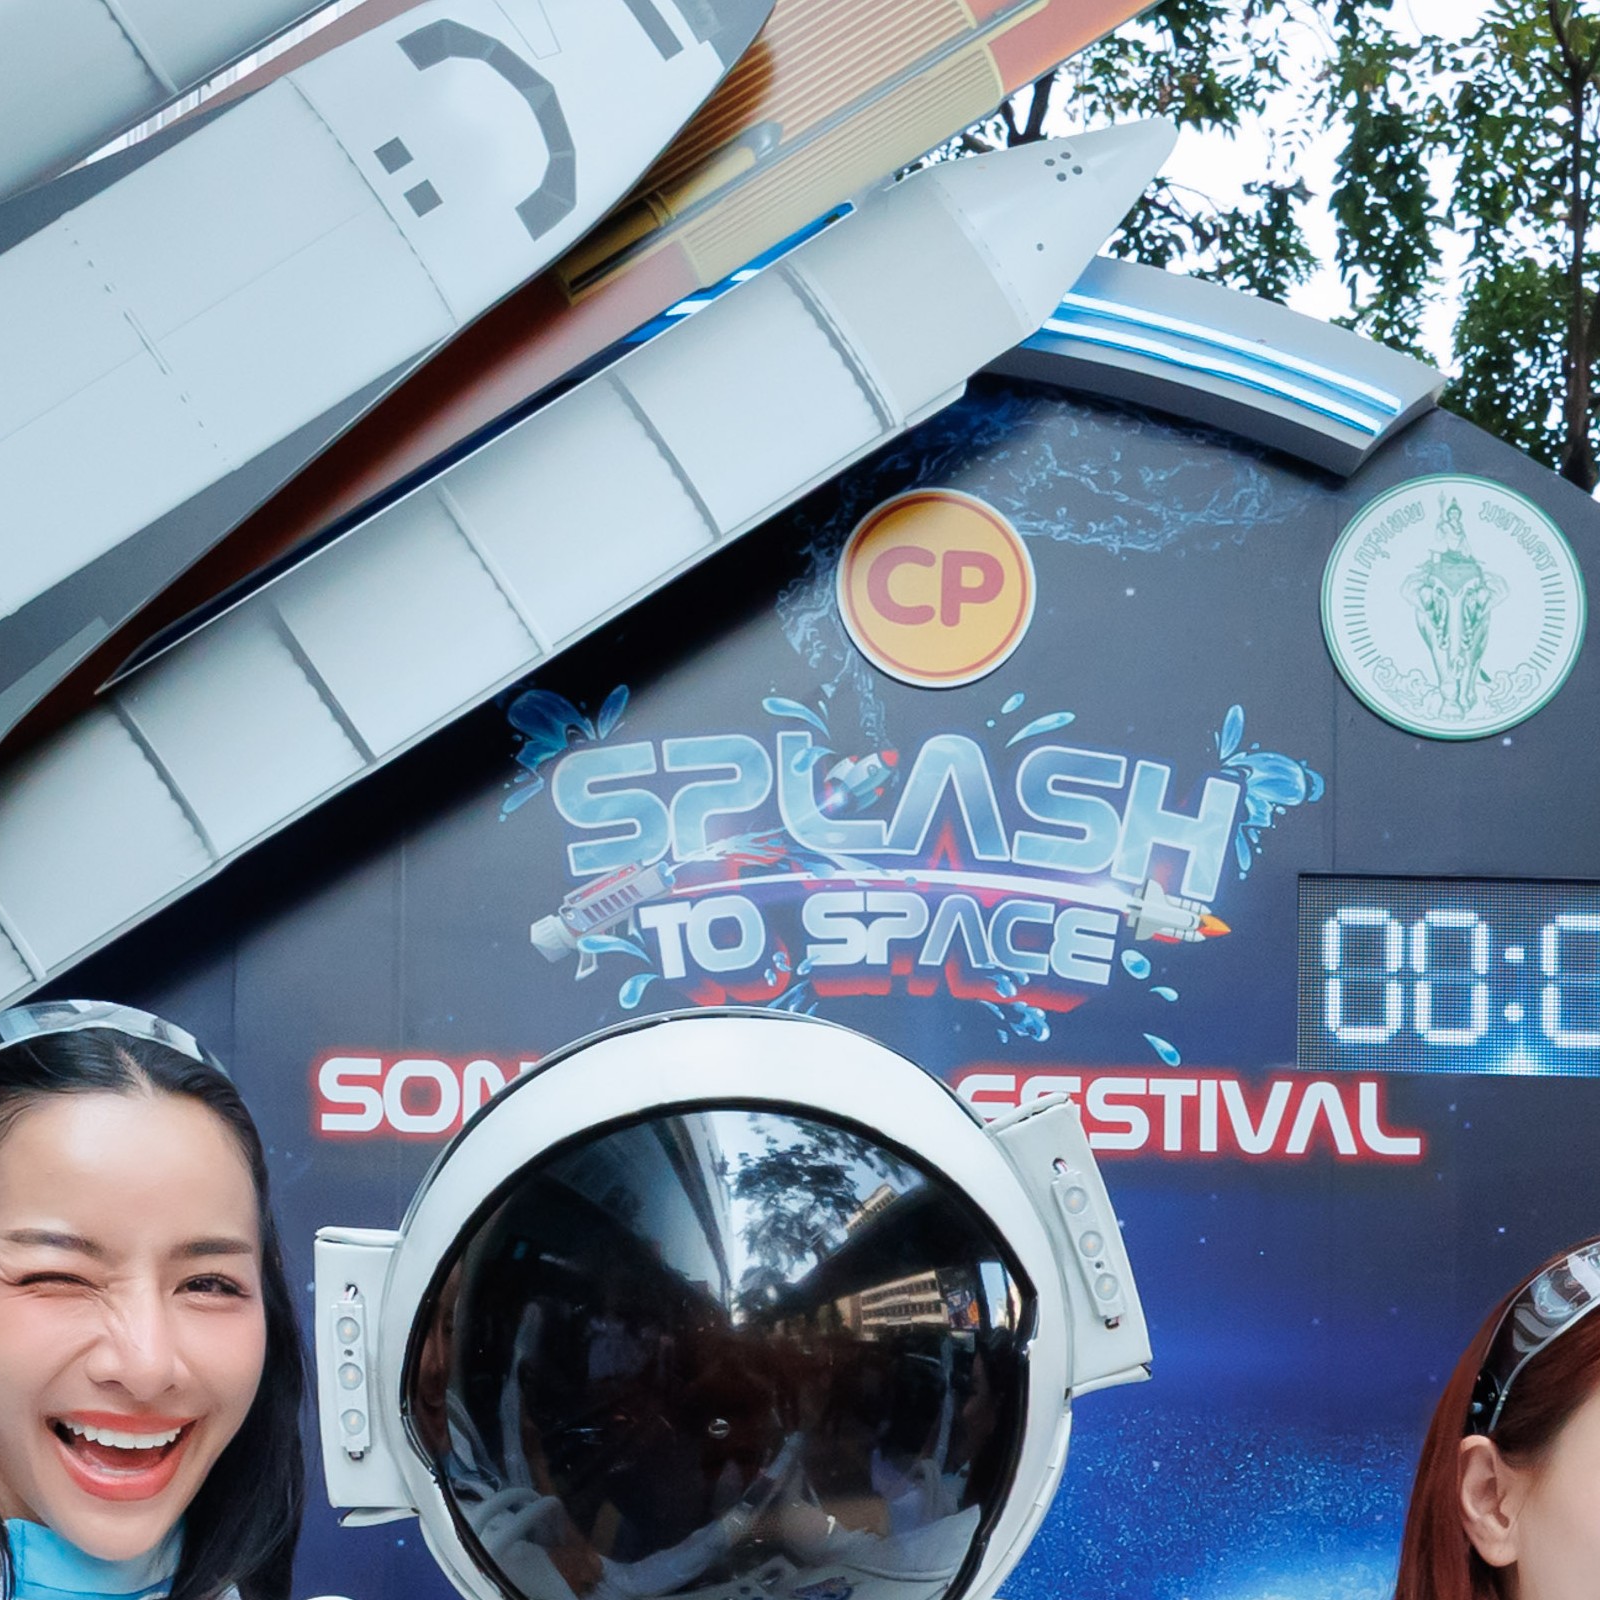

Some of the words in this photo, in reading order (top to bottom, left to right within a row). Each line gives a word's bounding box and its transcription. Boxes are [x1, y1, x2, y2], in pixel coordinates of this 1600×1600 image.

[866, 545, 1005, 627] CP
[551, 730, 1241, 903] SPLASH
[638, 895, 766, 980] TO
[802, 891, 1120, 985] SPACE
